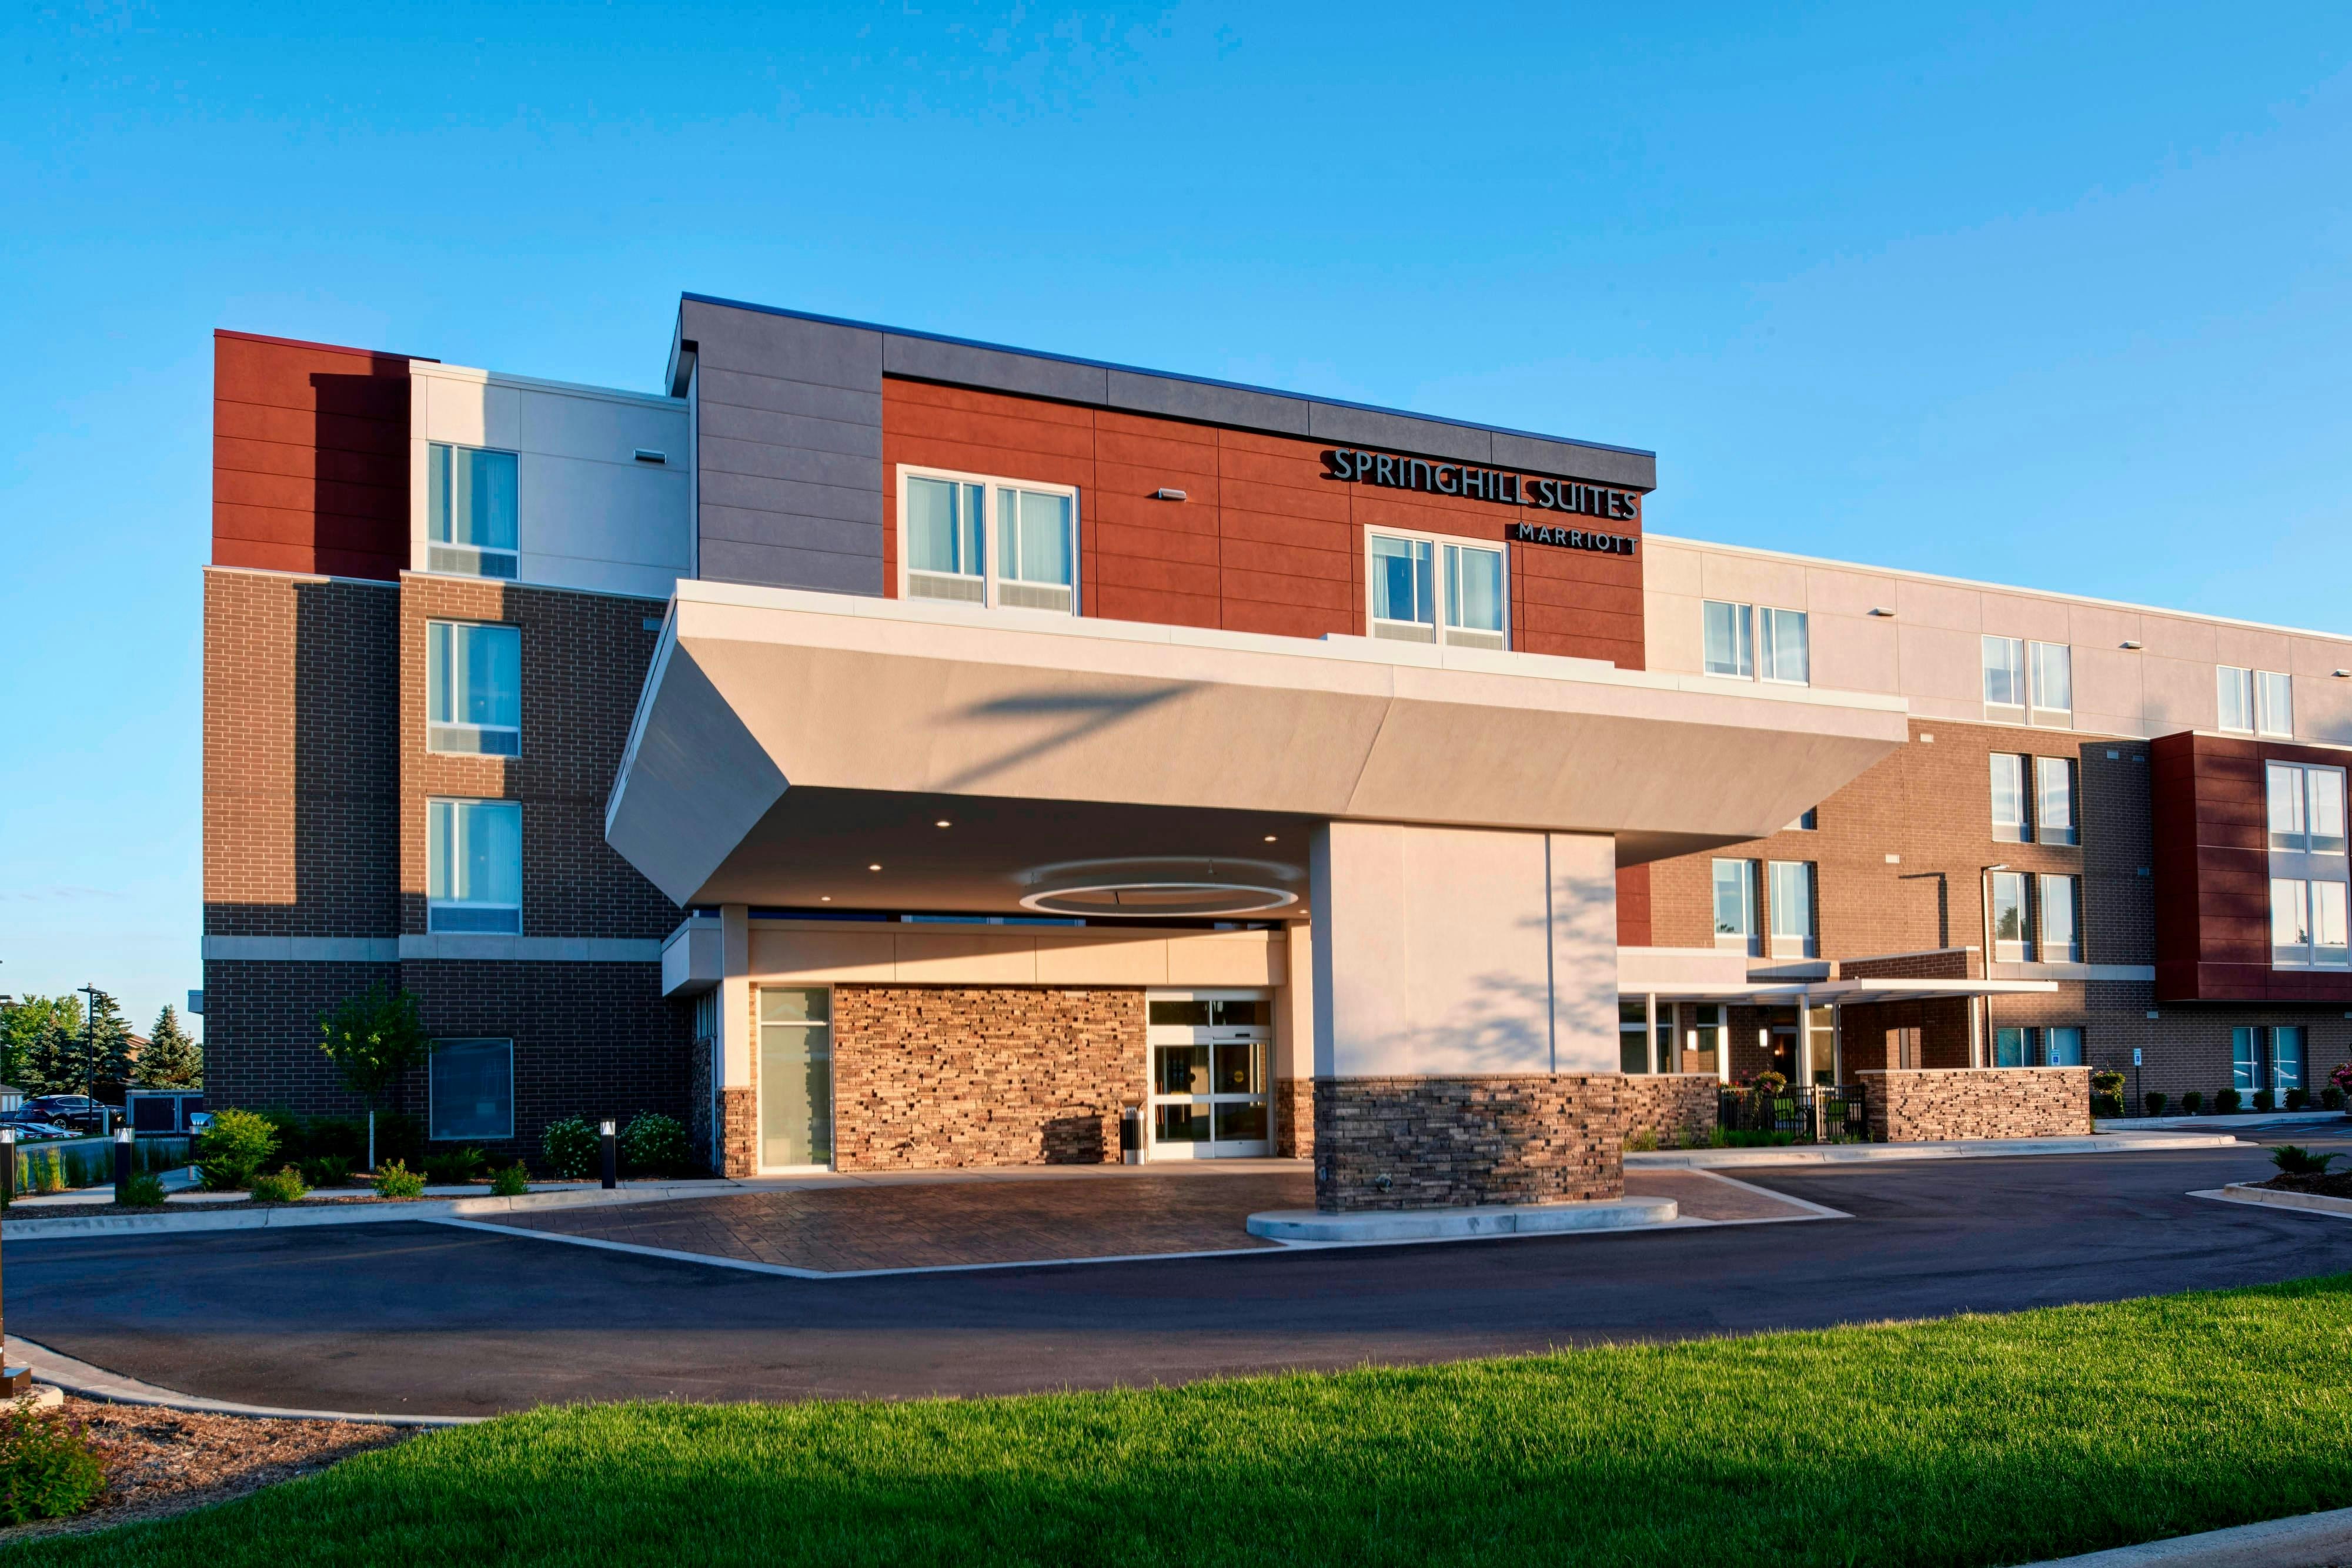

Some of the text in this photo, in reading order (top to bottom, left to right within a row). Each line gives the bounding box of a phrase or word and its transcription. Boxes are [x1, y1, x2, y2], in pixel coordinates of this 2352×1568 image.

[1334, 448, 1639, 520] SPRINGHILL SUITES
[1519, 521, 1639, 554] MARRIOTT
